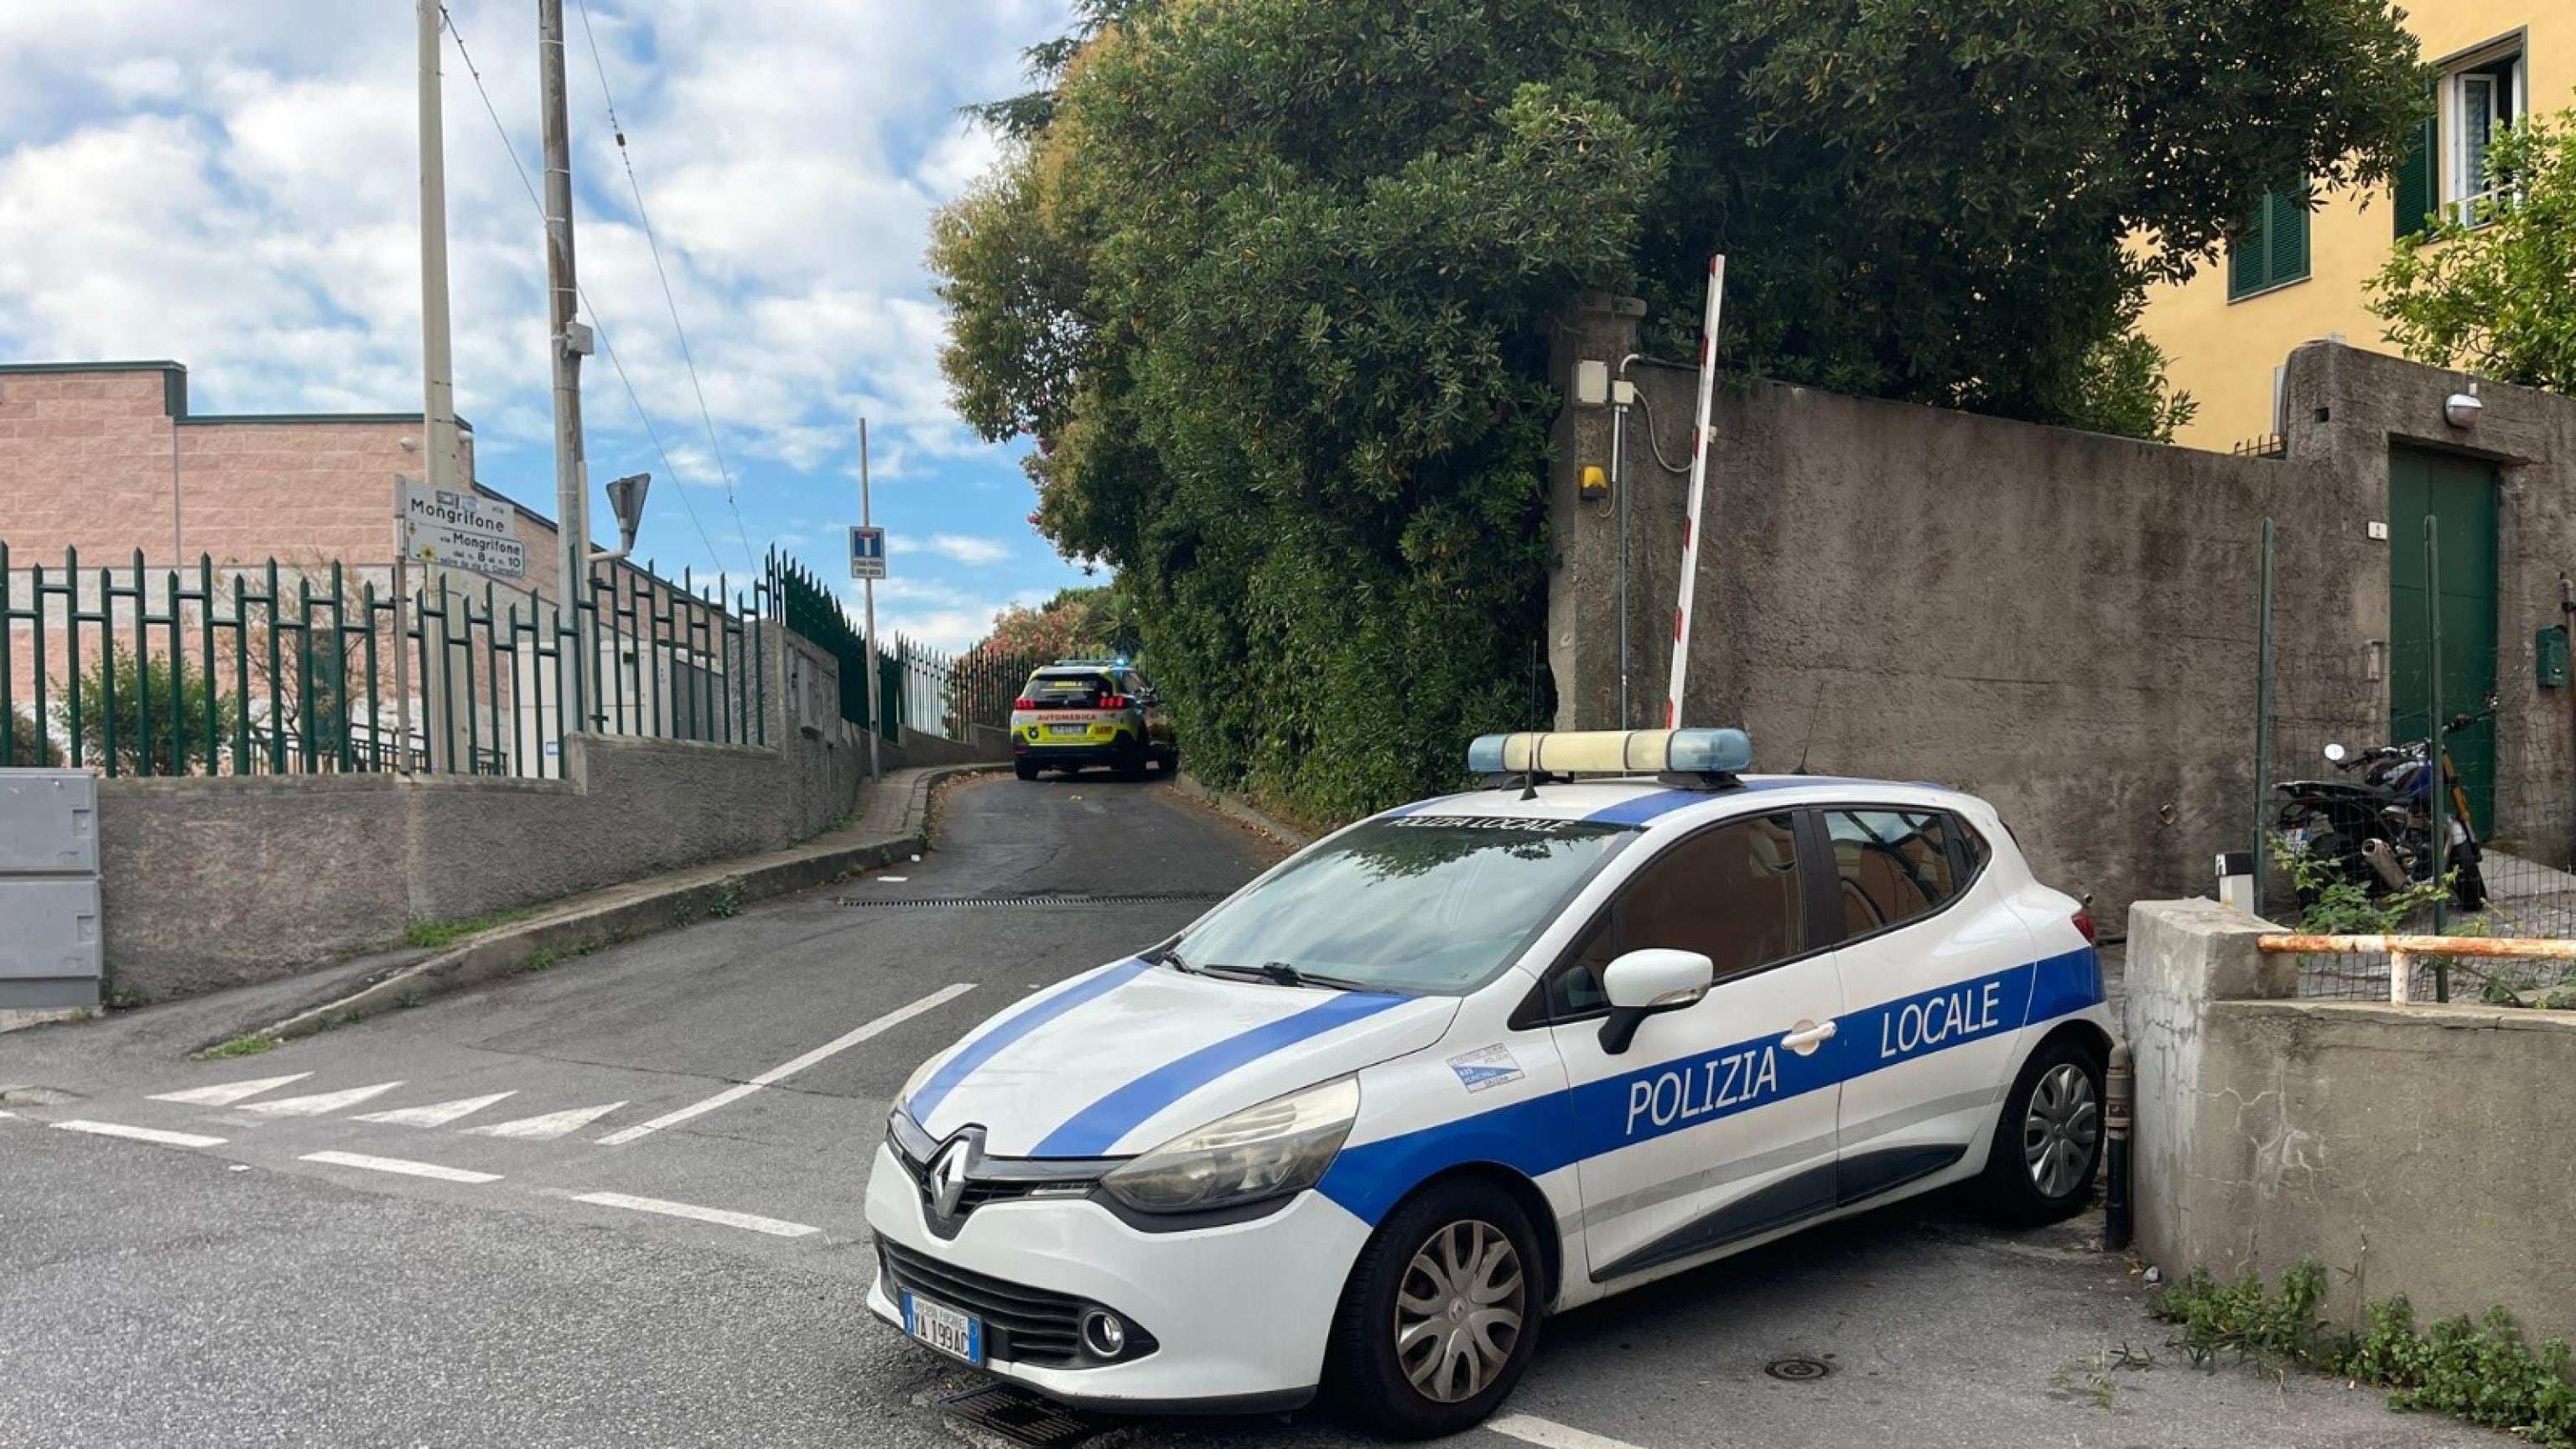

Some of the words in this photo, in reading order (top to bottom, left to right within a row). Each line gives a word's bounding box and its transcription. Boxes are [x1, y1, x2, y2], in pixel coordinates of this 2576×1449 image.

[411, 498, 505, 532] Mongrifone
[454, 532, 520, 555] Mongrifone
[508, 557, 521, 568] 10
[1625, 1046, 1777, 1135] POLIZIA
[1881, 981, 2000, 1059] LOCALE
